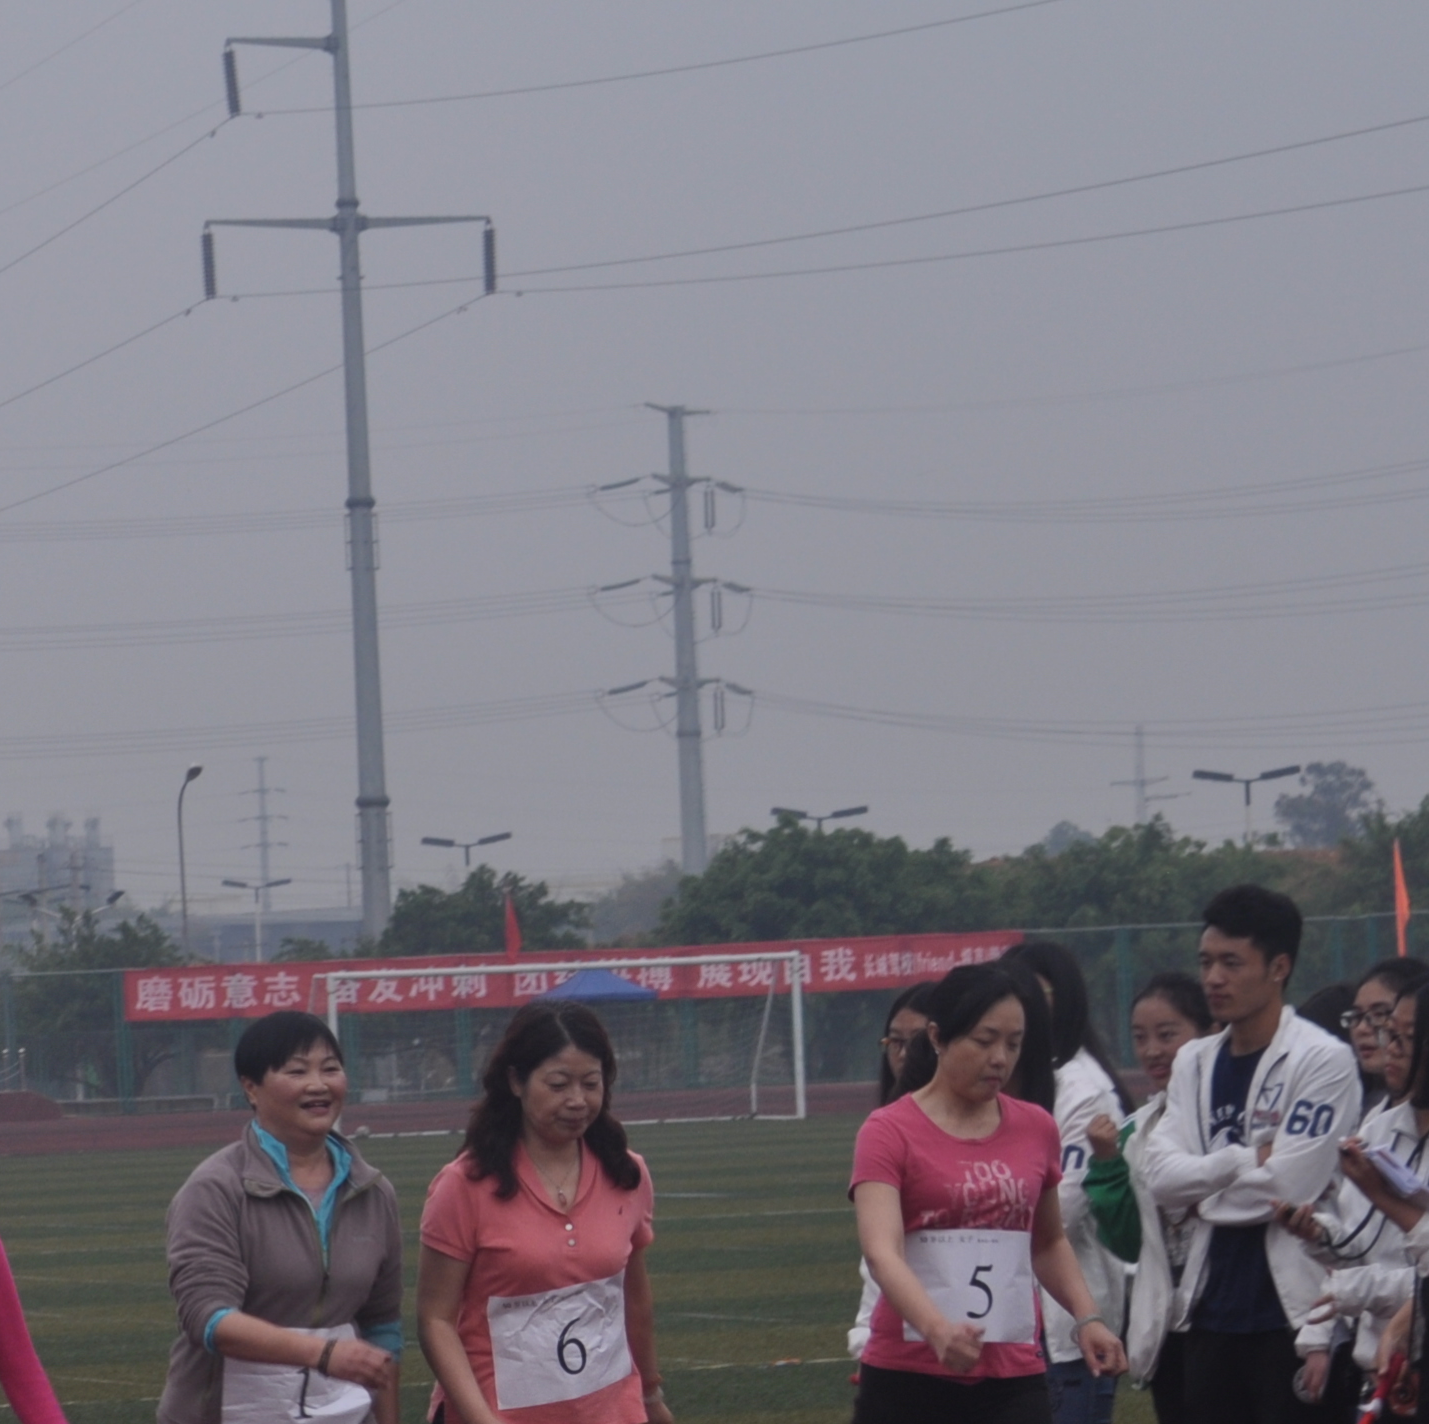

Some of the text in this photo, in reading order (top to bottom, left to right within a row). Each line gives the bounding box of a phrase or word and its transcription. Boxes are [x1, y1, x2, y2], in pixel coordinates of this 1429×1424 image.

[135, 971, 302, 1012] 磨砺意志
[514, 956, 673, 997] 团搏
[1285, 1099, 1335, 1139] 60
[966, 1264, 993, 1318] 5
[557, 1317, 587, 1375] 6
[294, 1366, 313, 1420] 1
